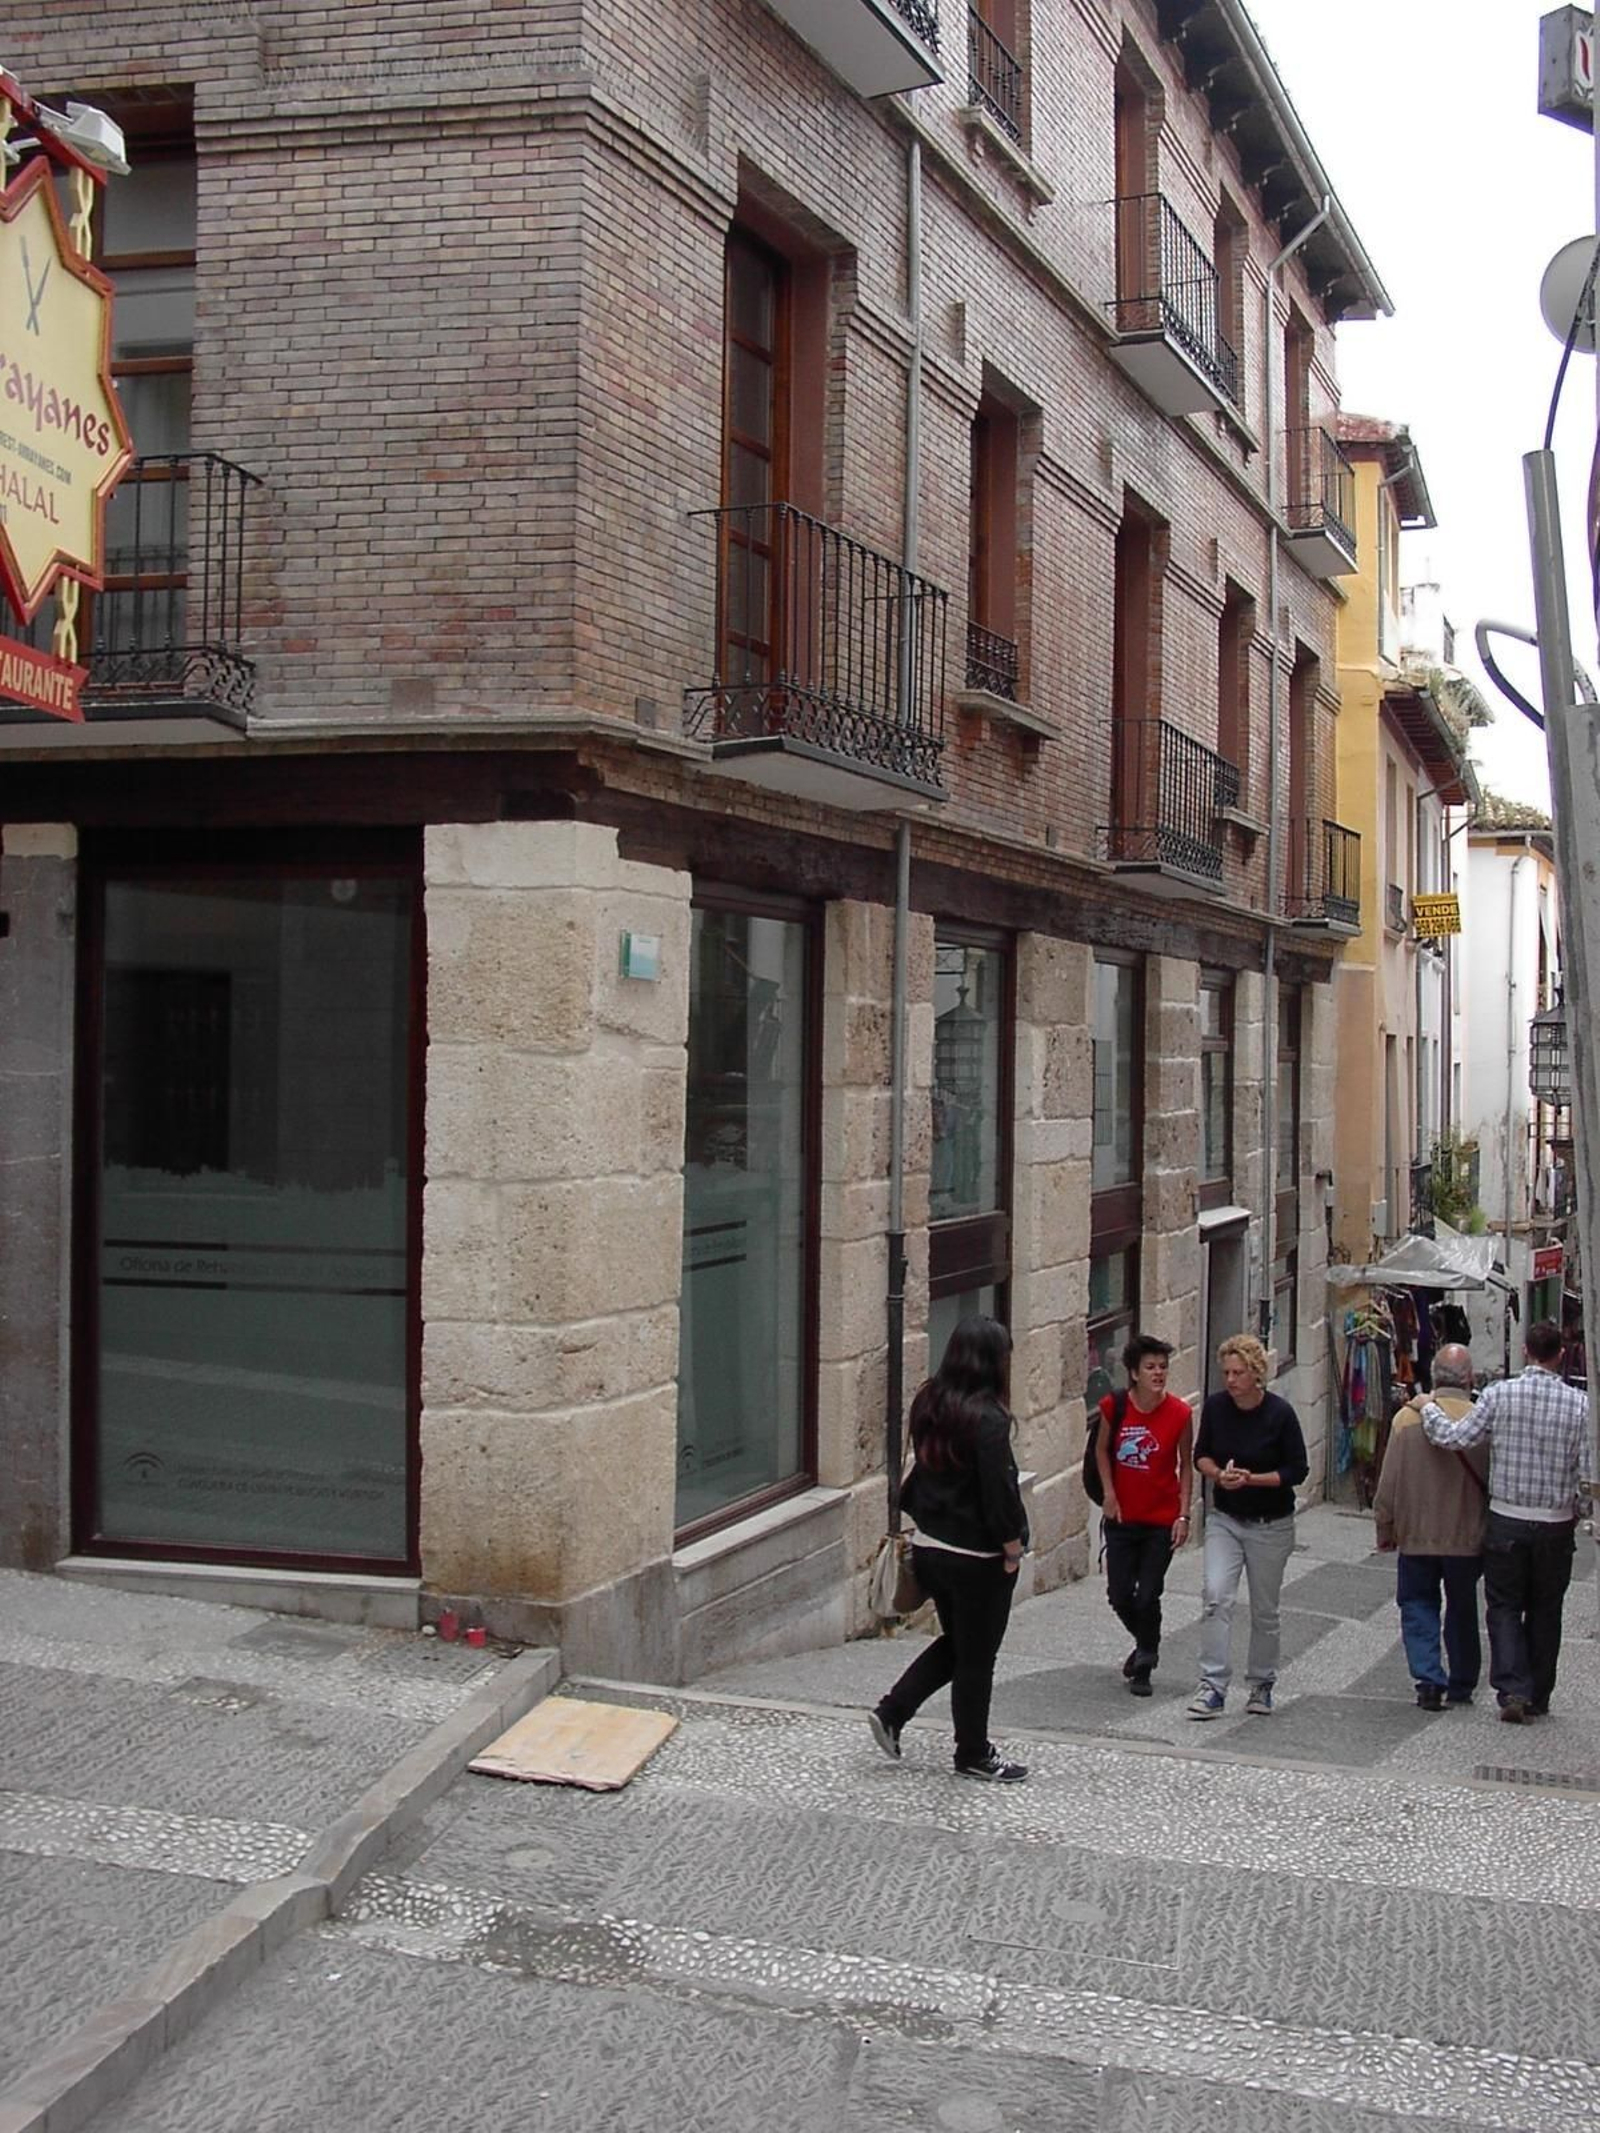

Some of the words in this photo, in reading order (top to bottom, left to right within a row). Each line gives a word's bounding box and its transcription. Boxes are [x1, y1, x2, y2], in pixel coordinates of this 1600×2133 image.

[0, 353, 110, 456] ayanes
[1416, 904, 1458, 917] VENDE
[174, 1259, 193, 1274] de
